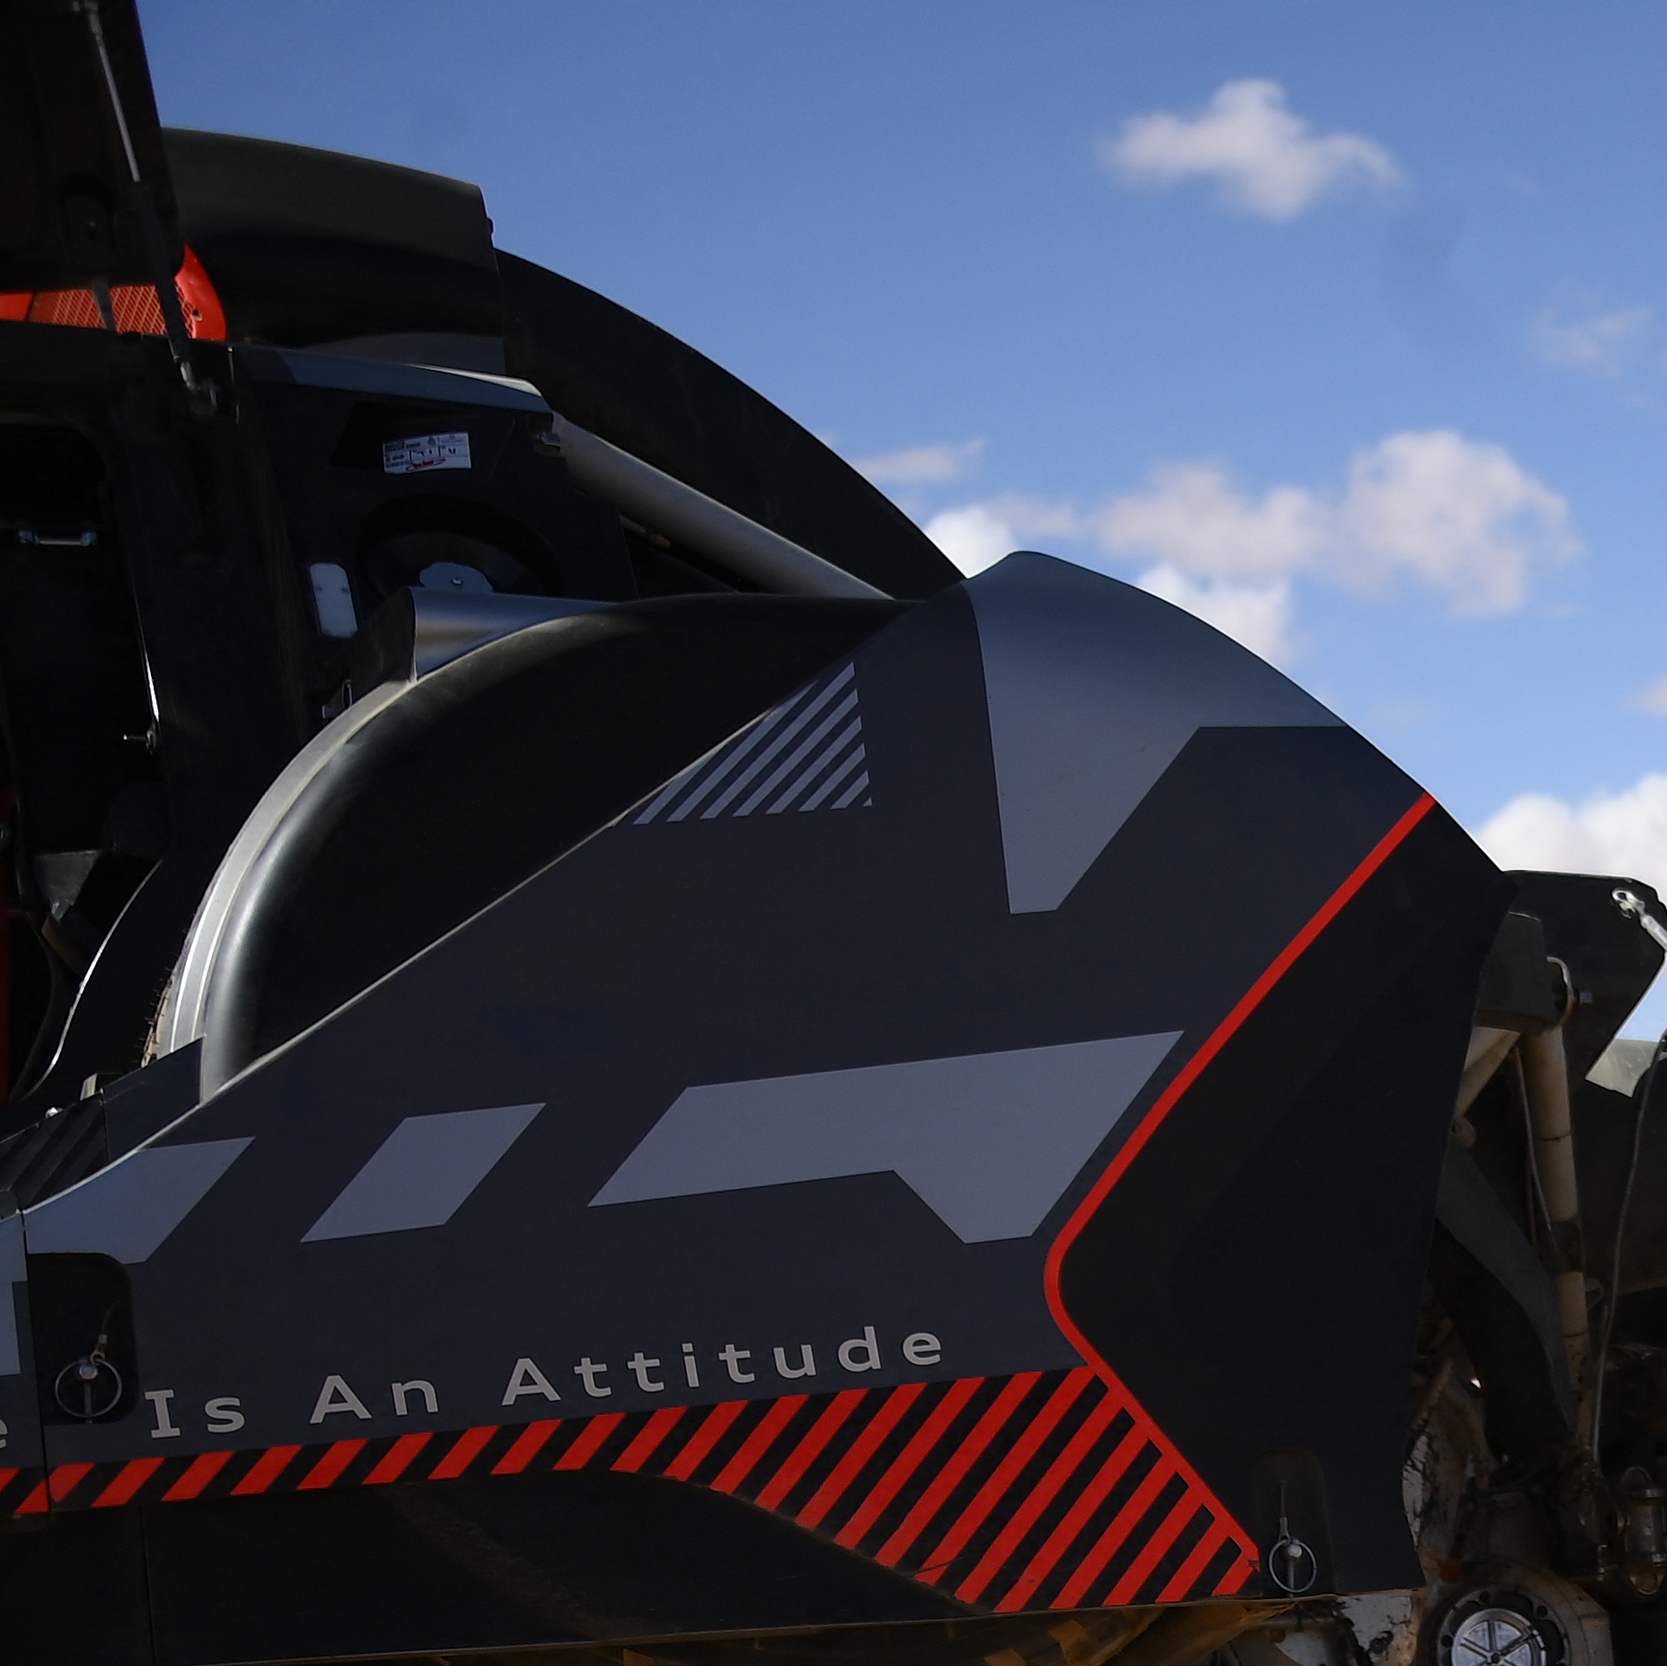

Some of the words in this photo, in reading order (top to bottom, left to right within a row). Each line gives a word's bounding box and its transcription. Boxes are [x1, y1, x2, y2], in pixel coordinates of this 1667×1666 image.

[145, 1388, 246, 1440] Is
[309, 1374, 441, 1425] An
[501, 1325, 944, 1406] Attitude
